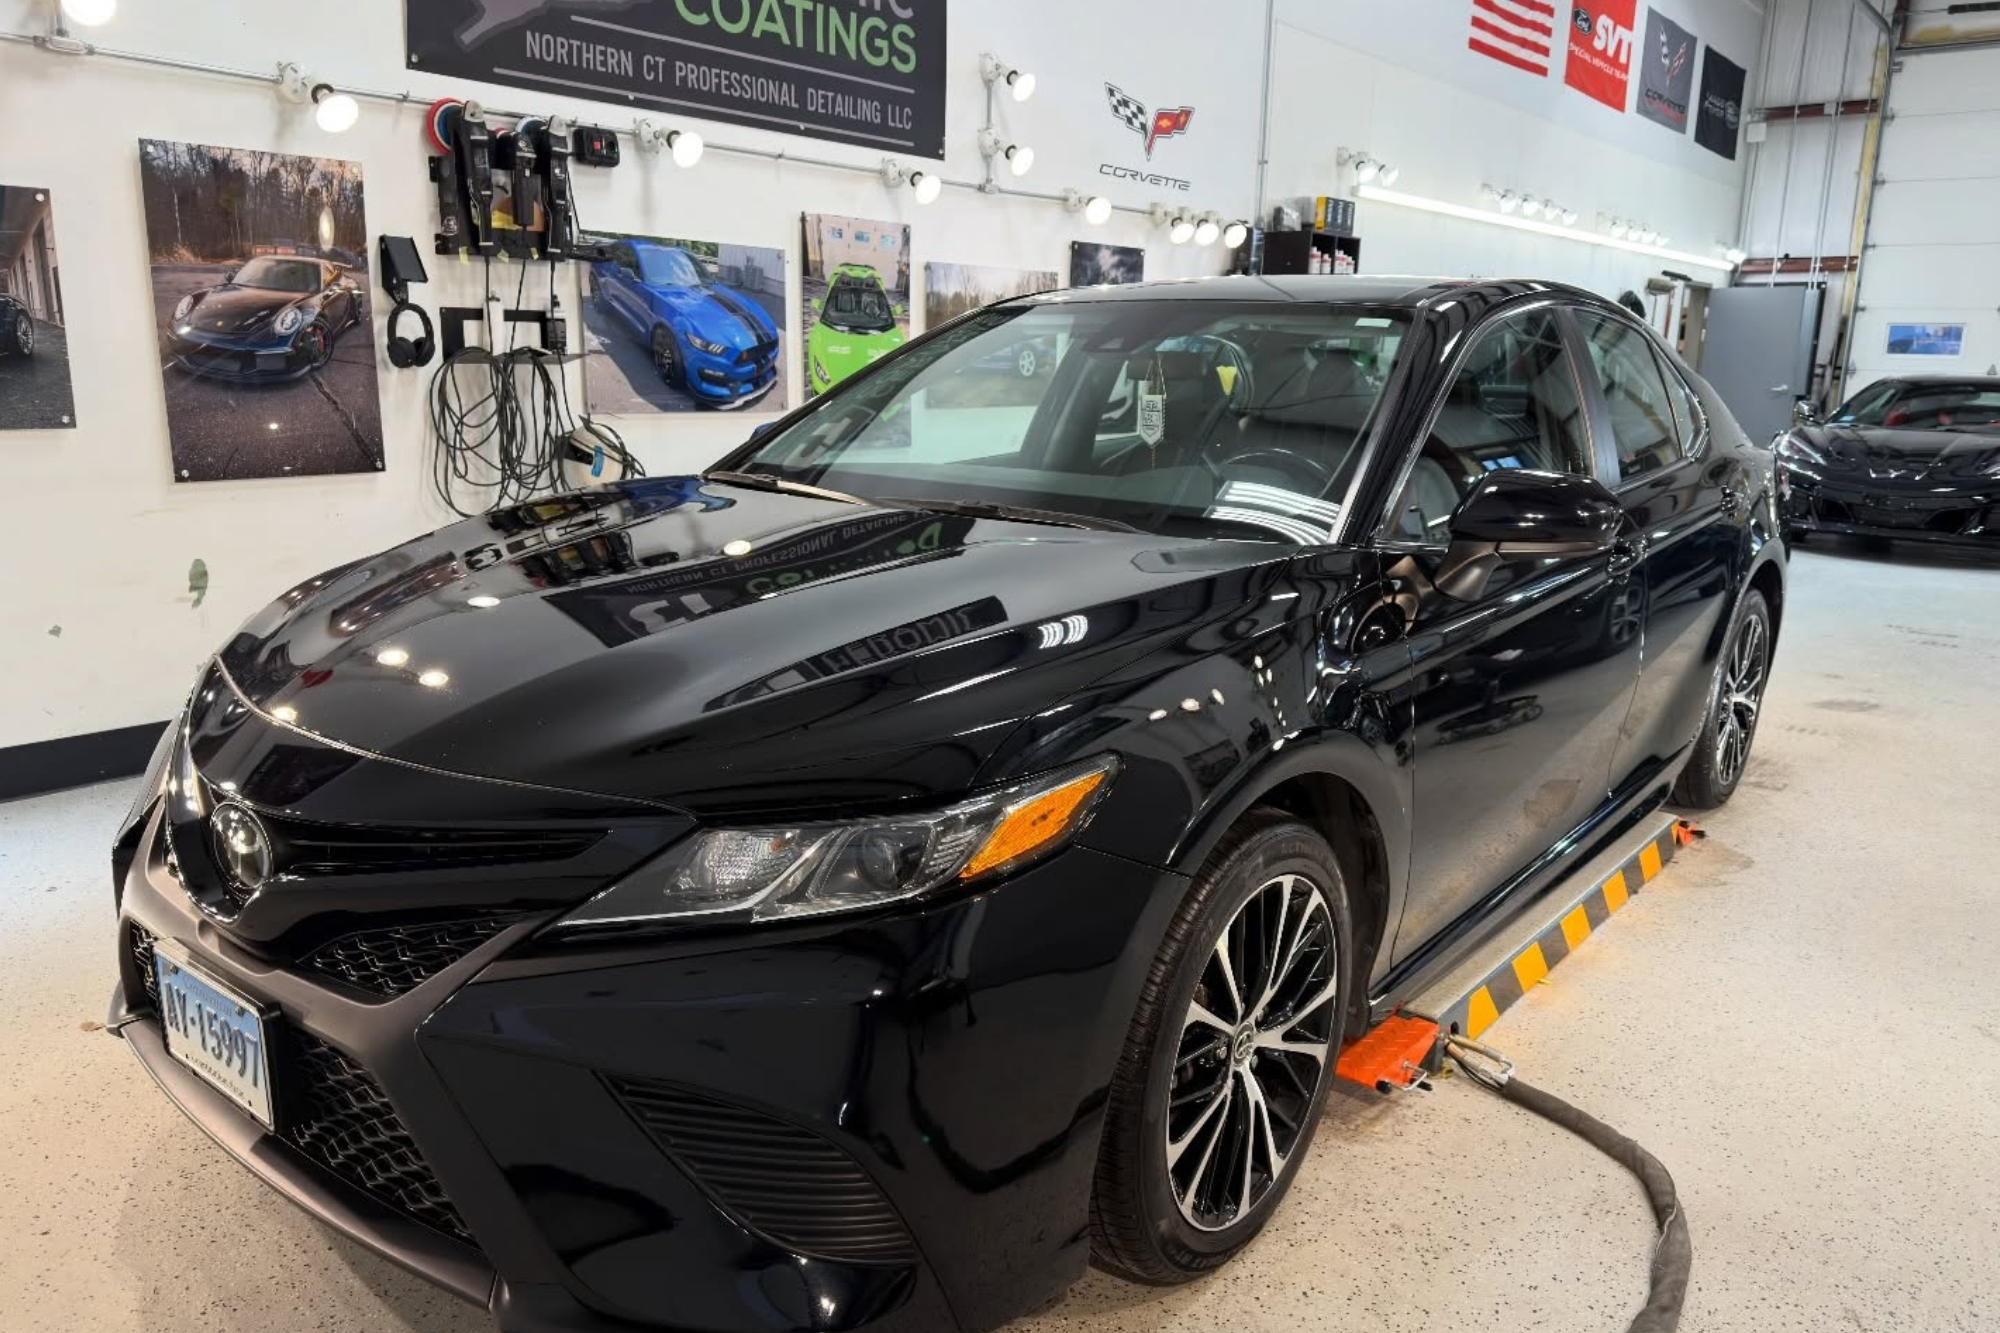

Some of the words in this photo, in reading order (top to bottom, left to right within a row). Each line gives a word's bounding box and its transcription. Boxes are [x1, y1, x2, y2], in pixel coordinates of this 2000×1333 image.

[1593, 14, 1633, 64] SVT
[526, 30, 633, 77] NORTHERN
[643, 54, 666, 83] CT
[675, 61, 799, 109] PROFESSIONAL
[807, 88, 881, 124] DETAILING
[888, 103, 913, 130] LLC
[1099, 163, 1191, 191] CORVETTE
